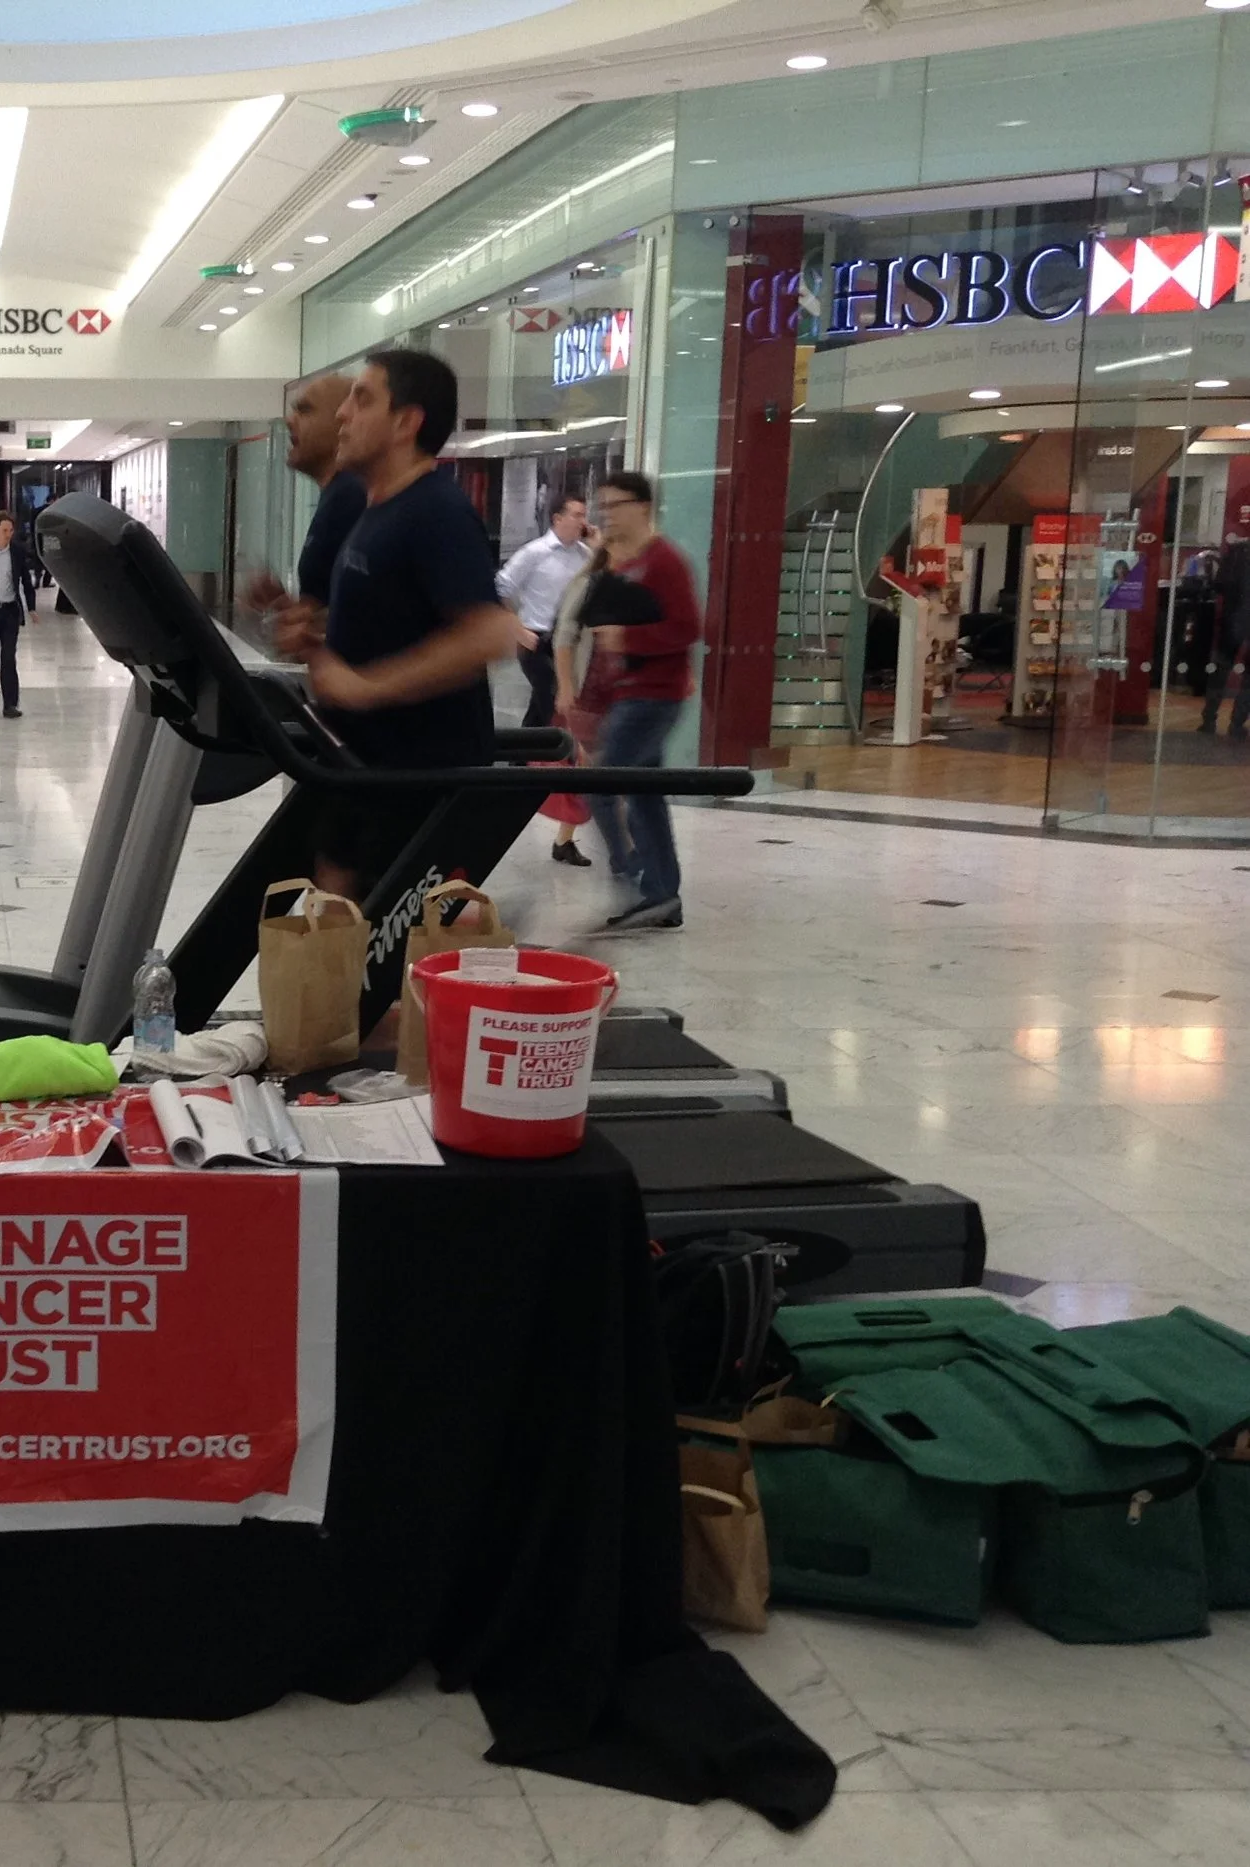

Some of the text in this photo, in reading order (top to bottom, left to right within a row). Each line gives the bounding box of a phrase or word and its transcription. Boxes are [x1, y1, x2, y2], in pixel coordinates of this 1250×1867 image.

[826, 242, 1086, 334] HSBC
[28, 345, 63, 357] Square
[551, 315, 609, 386] HSBC
[483, 1017, 592, 1032] PLEASE SUPPORT
[518, 1072, 574, 1088] TRUST
